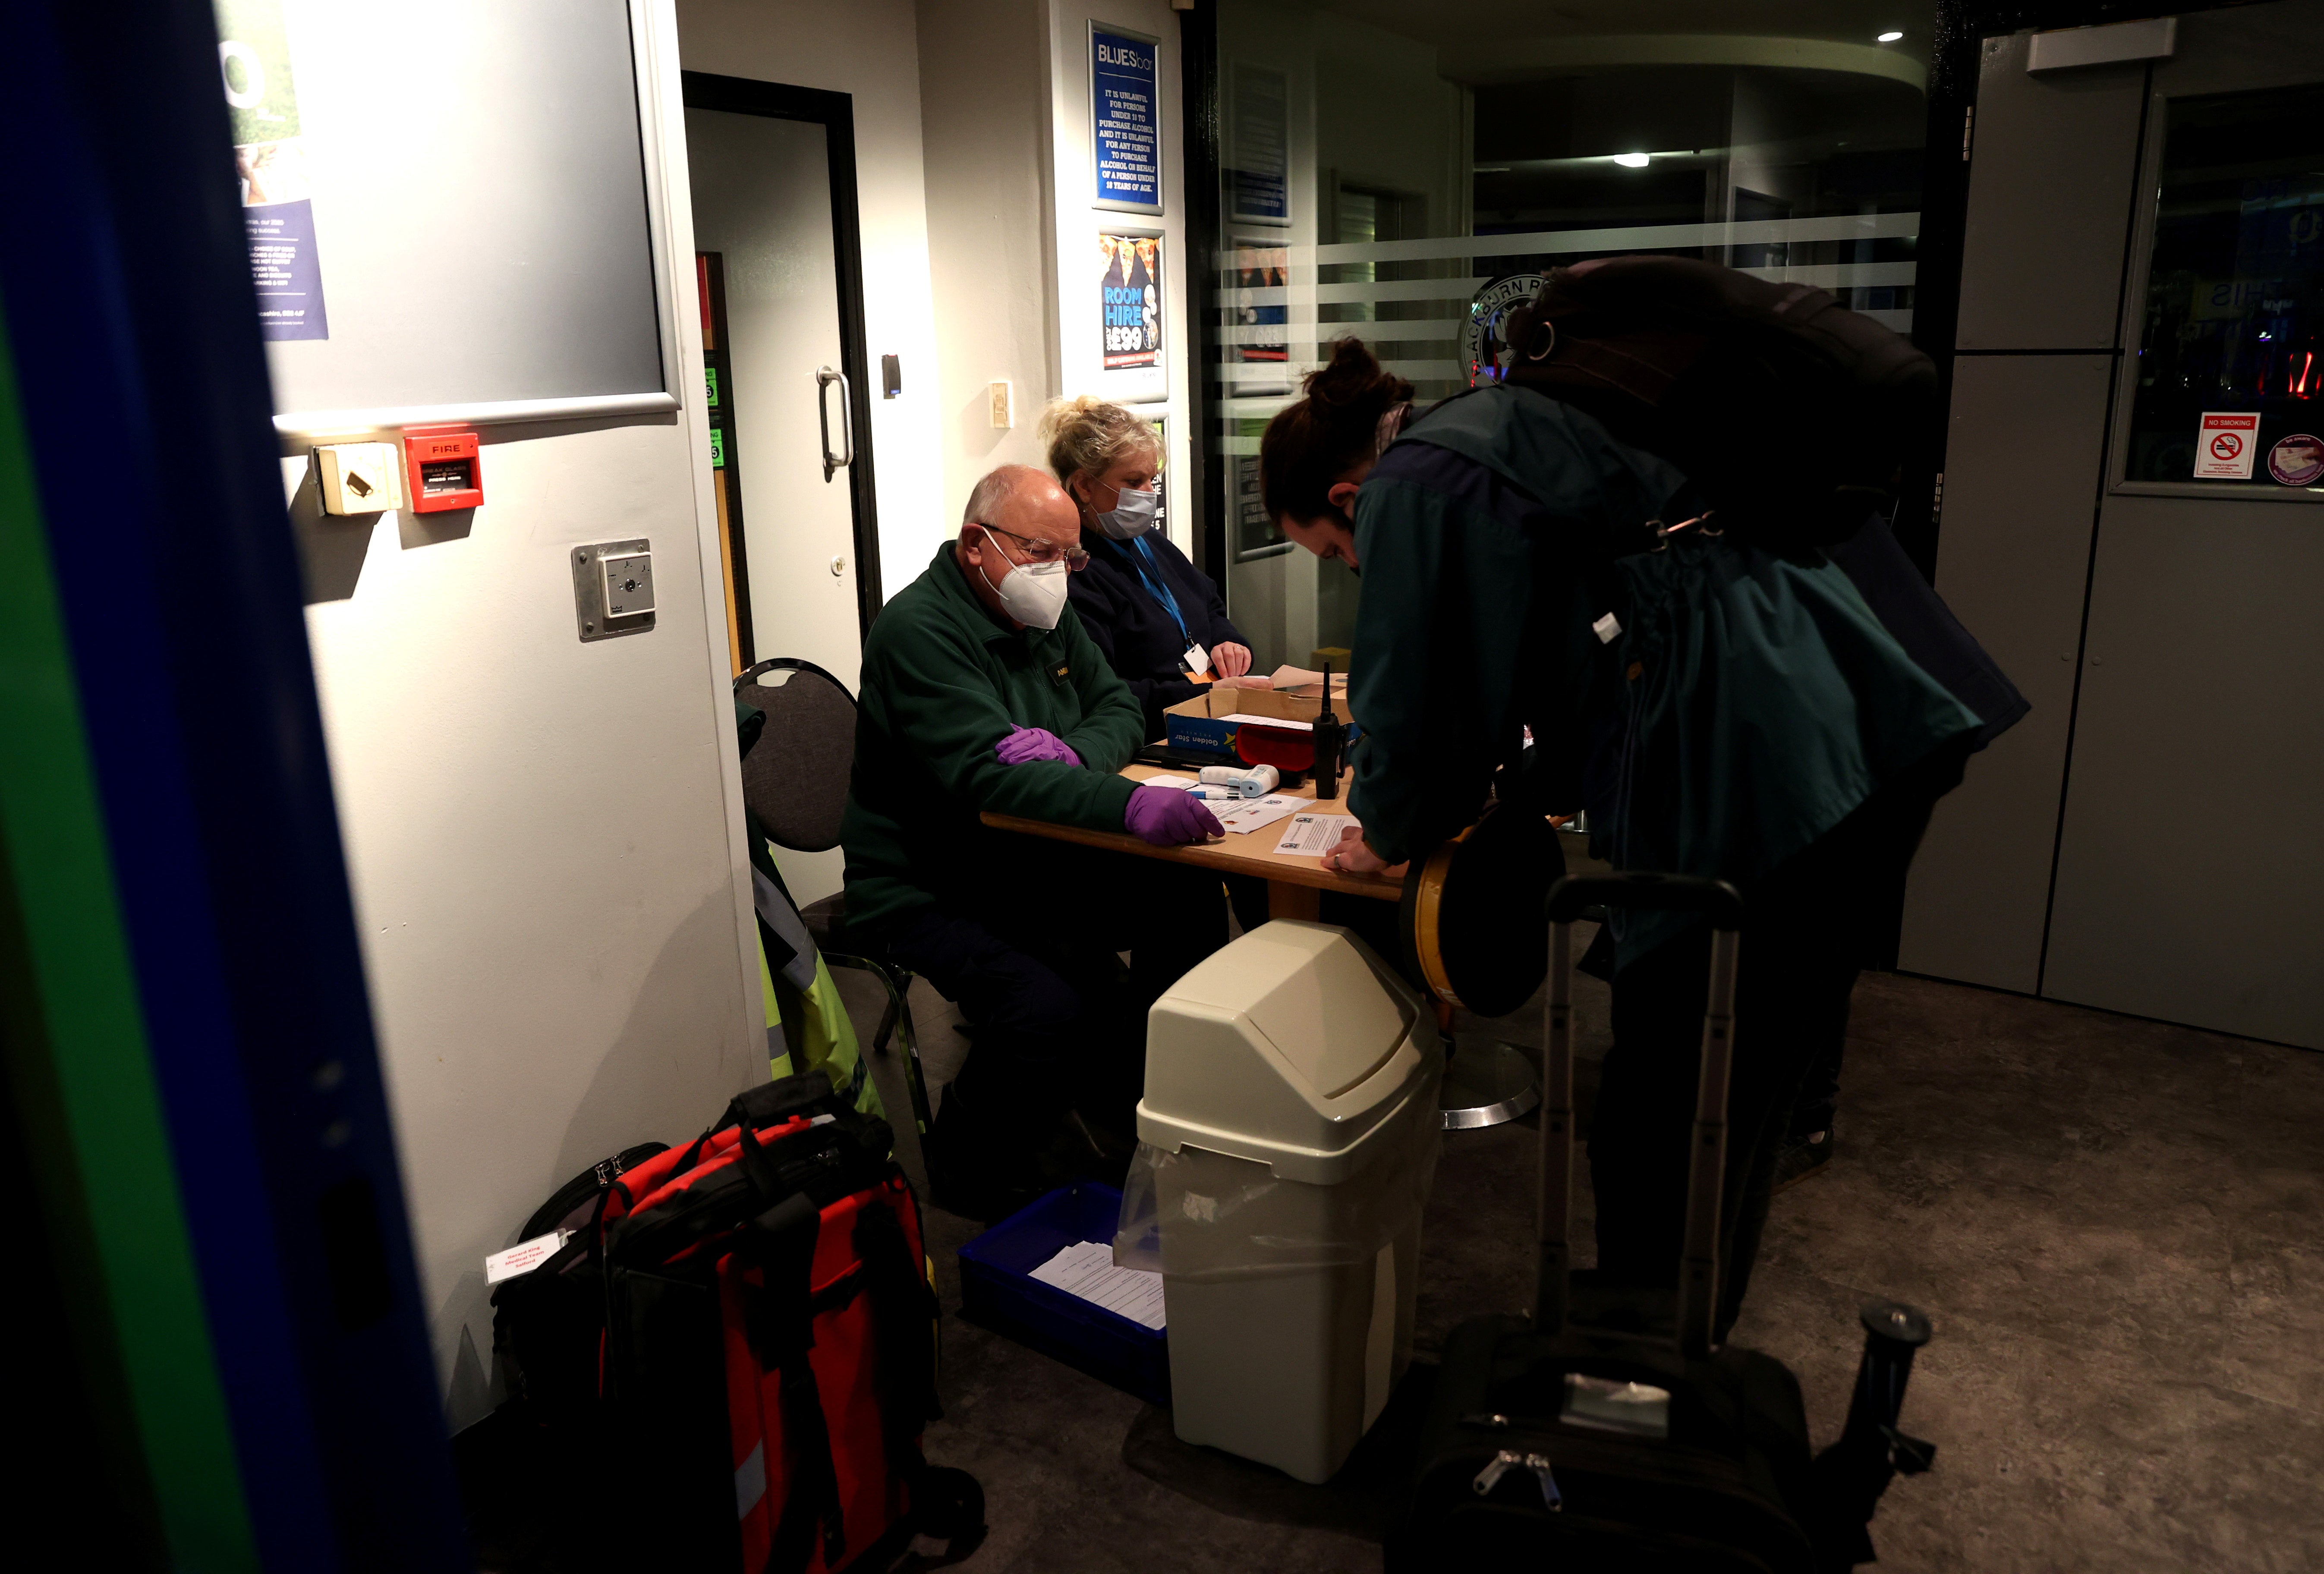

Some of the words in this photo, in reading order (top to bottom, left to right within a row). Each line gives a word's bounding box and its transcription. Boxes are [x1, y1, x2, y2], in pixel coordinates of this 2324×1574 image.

[1119, 92, 1148, 103] UNLAWFUL
[1110, 100, 1122, 108] FOR
[1123, 102, 1146, 112] PERSONS
[1111, 110, 1131, 120] UNDER
[1099, 120, 1131, 129] PURCHASE
[1132, 123, 1154, 134] ALCOHOL
[1128, 133, 1154, 144] UNLAWFUL
[1105, 140, 1118, 148] FOR
[1119, 142, 1131, 150] ANY
[1131, 144, 1150, 153] PERSON
[1120, 152, 1148, 162] PURCHASE
[1100, 161, 1127, 170] ALCOHOL
[1136, 164, 1156, 173] BEHALF
[1116, 172, 1137, 181] PERSON
[1138, 174, 1155, 183] UNDER
[1113, 182, 1131, 190] YEARS
[1105, 286, 1142, 305] ROOM
[1105, 305, 1143, 327] HIRE
[433, 445, 460, 453] FIRE
[1192, 737, 1219, 746] Golden
[507, 1250, 527, 1259] Gerard
[505, 1256, 527, 1265] Medical
[516, 1259, 535, 1268] Salford
